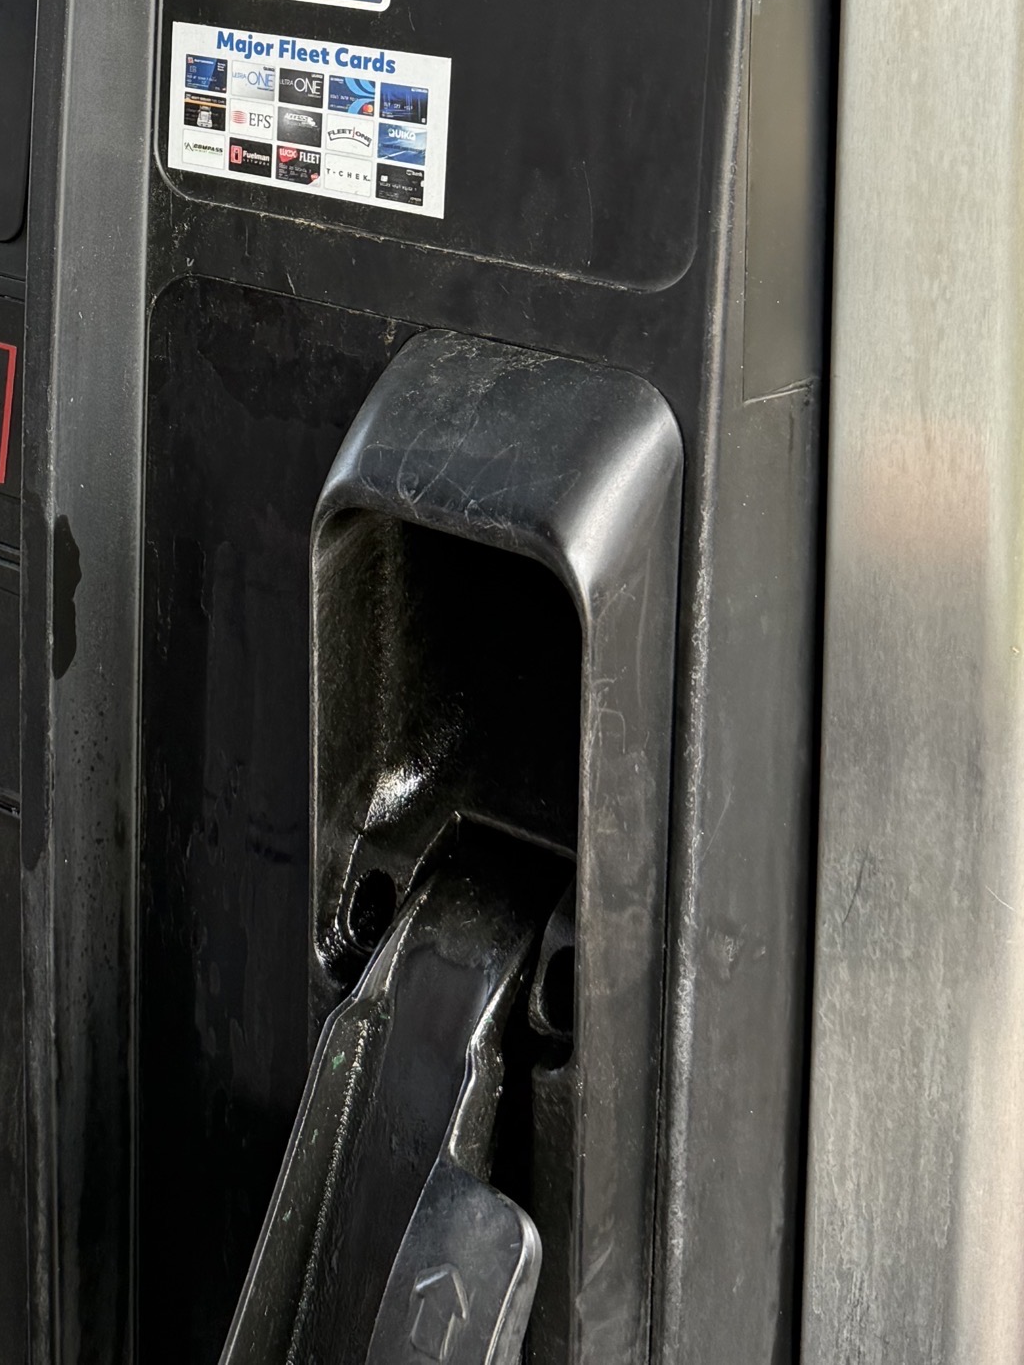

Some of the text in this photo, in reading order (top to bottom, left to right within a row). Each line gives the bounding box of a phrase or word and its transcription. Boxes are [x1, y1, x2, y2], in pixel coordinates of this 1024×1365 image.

[217, 31, 396, 74] Major Fleet Cards
[247, 71, 274, 86] ONE
[294, 77, 322, 95] ONE
[249, 112, 271, 129] EFS
[243, 150, 270, 162] Fuelman
[299, 151, 320, 165] FLEET
